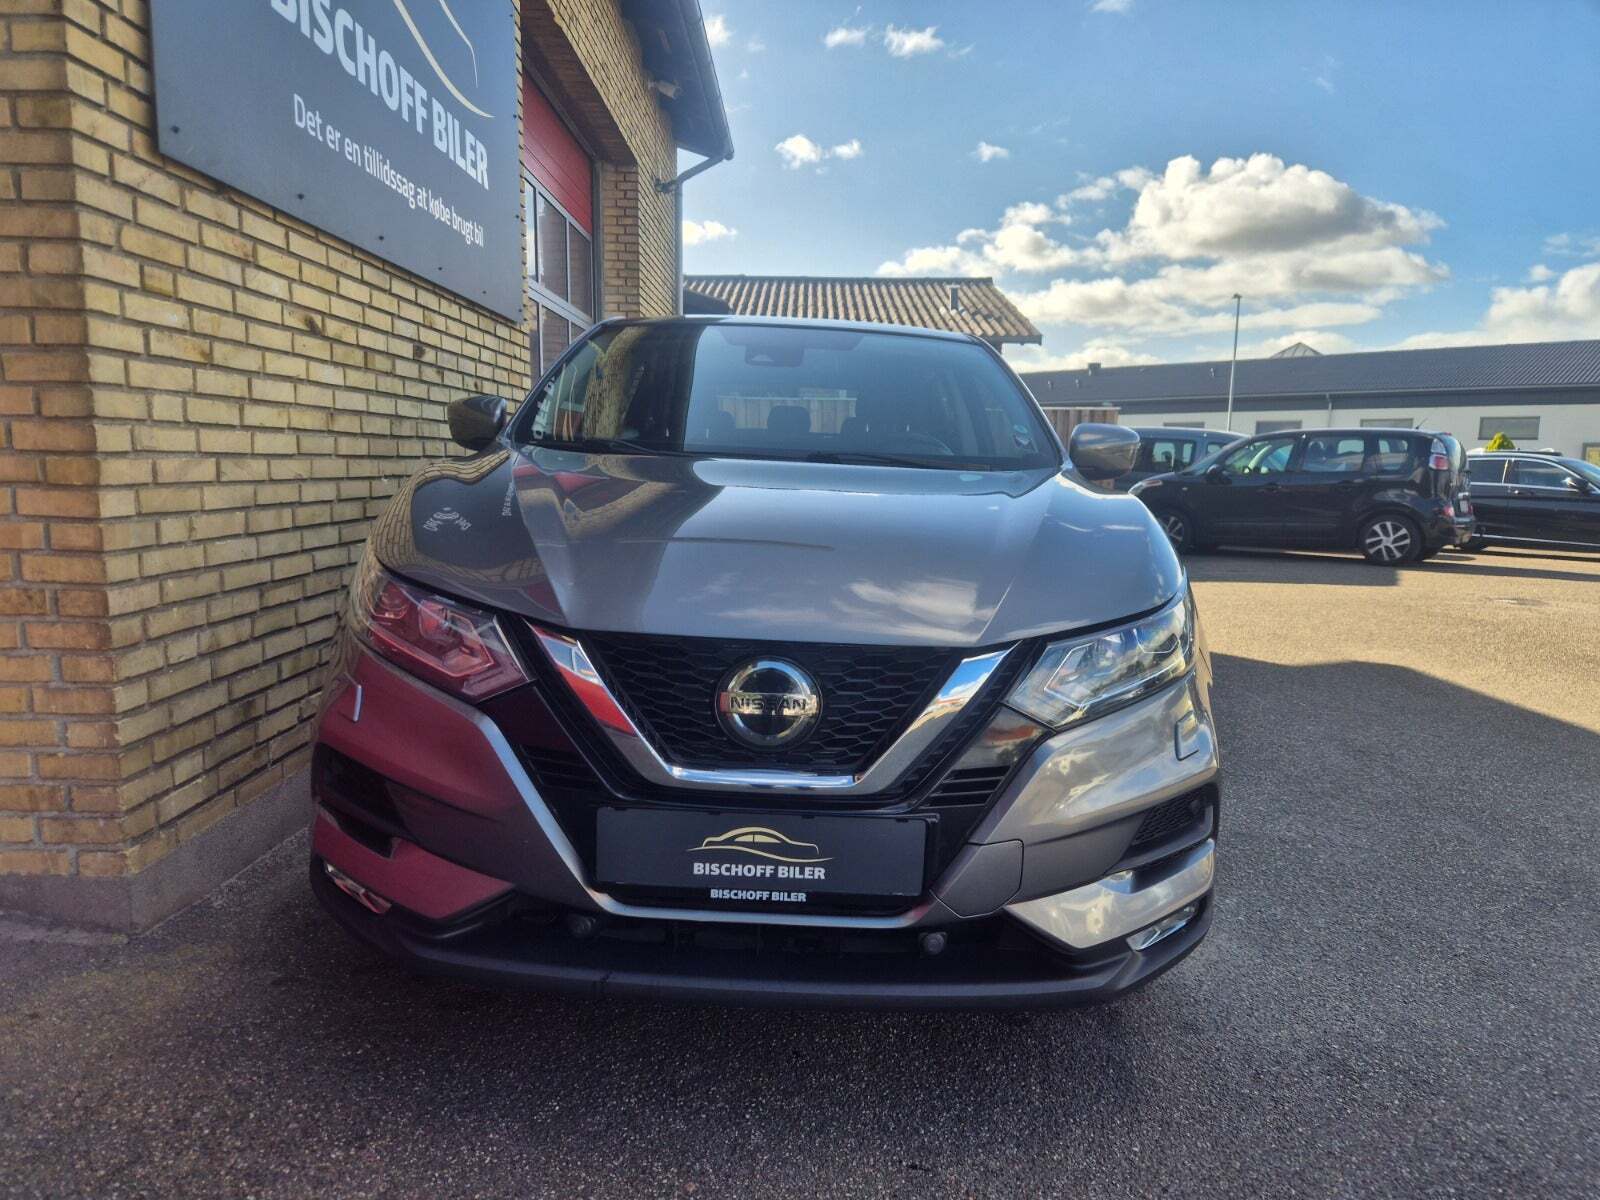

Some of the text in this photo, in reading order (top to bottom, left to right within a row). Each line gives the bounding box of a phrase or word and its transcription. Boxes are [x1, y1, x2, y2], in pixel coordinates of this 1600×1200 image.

[270, 0, 489, 190] ISCHOFF BILER
[294, 93, 483, 247] Det er en tillidssag at købe brugt bil
[730, 697, 807, 711] NISAN
[693, 862, 825, 879] BISCHOFF BILER
[710, 889, 806, 902] BISCHOFF BILER
